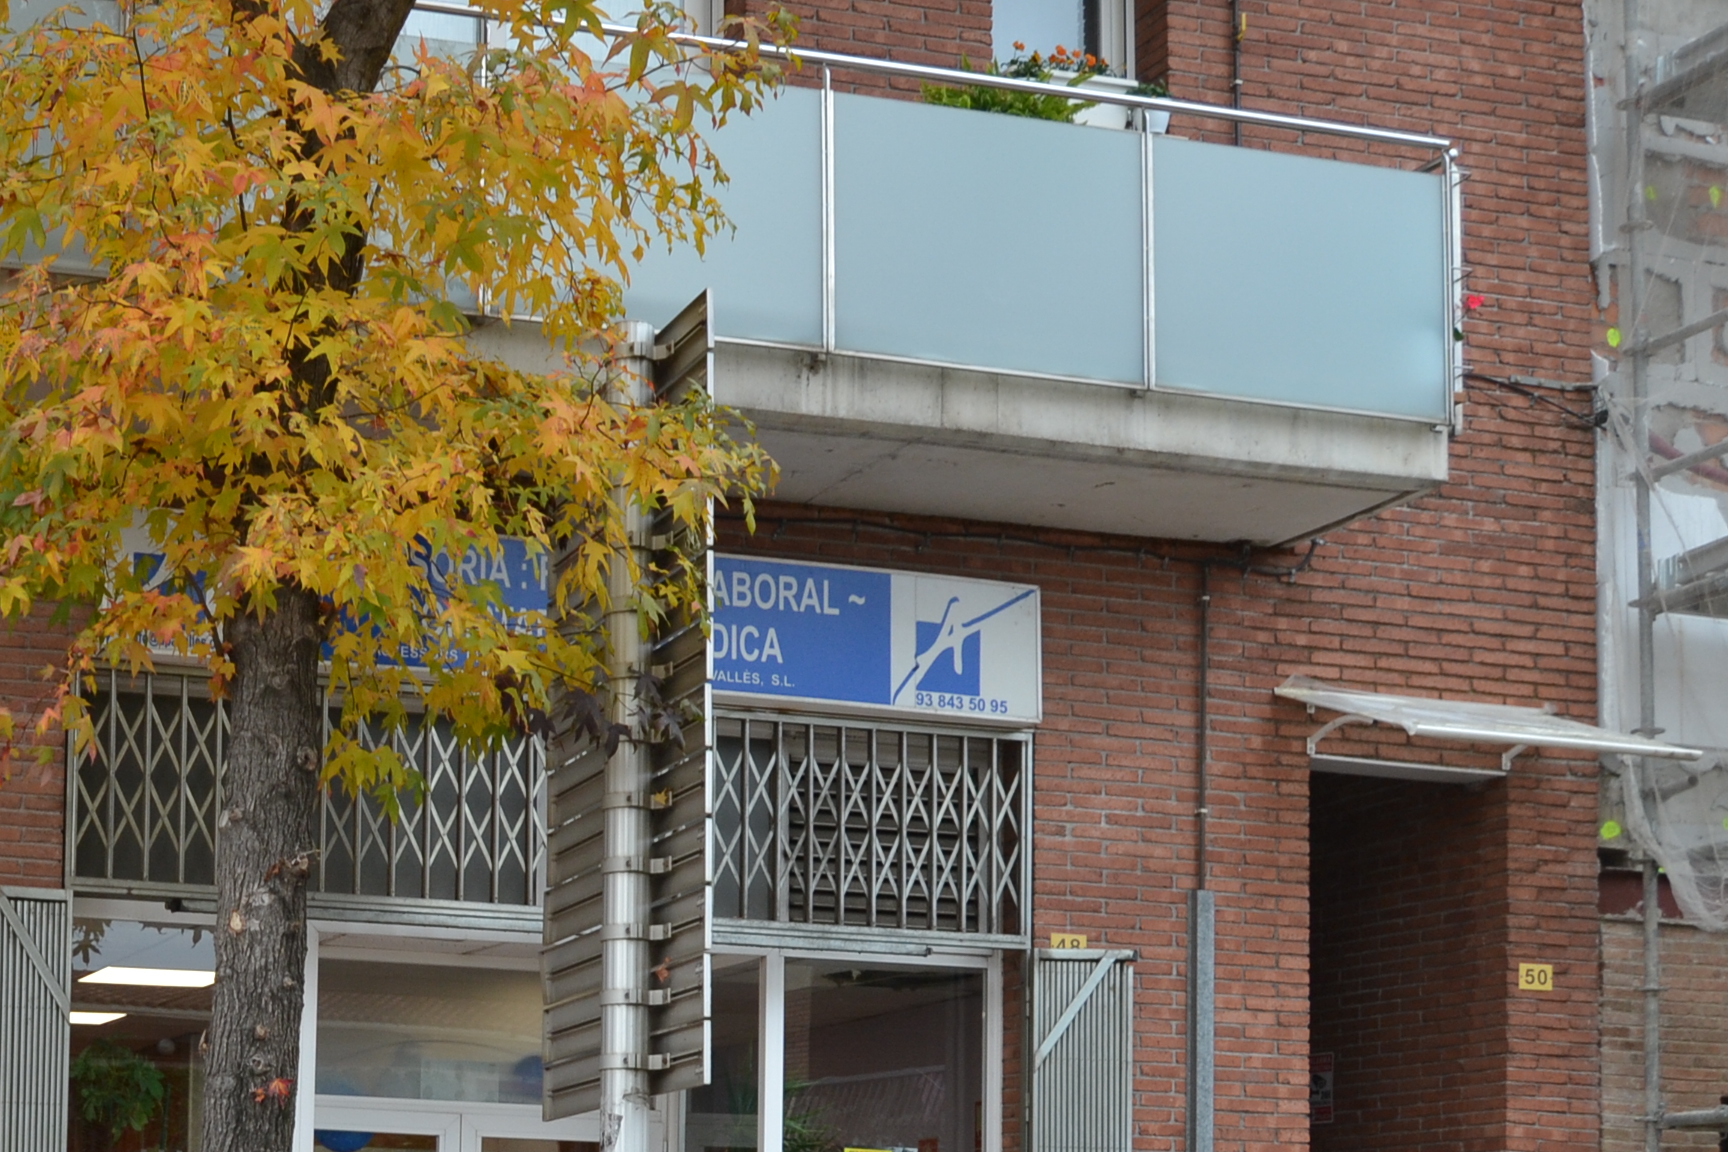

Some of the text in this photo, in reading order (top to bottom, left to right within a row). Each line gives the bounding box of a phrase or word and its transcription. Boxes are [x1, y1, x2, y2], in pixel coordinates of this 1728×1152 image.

[713, 569, 840, 616] ABORAL
[713, 622, 784, 664] DICA
[771, 674, 795, 687] S.L.
[915, 693, 1008, 714] 93 843 50 95
[1524, 968, 1548, 986] 50
